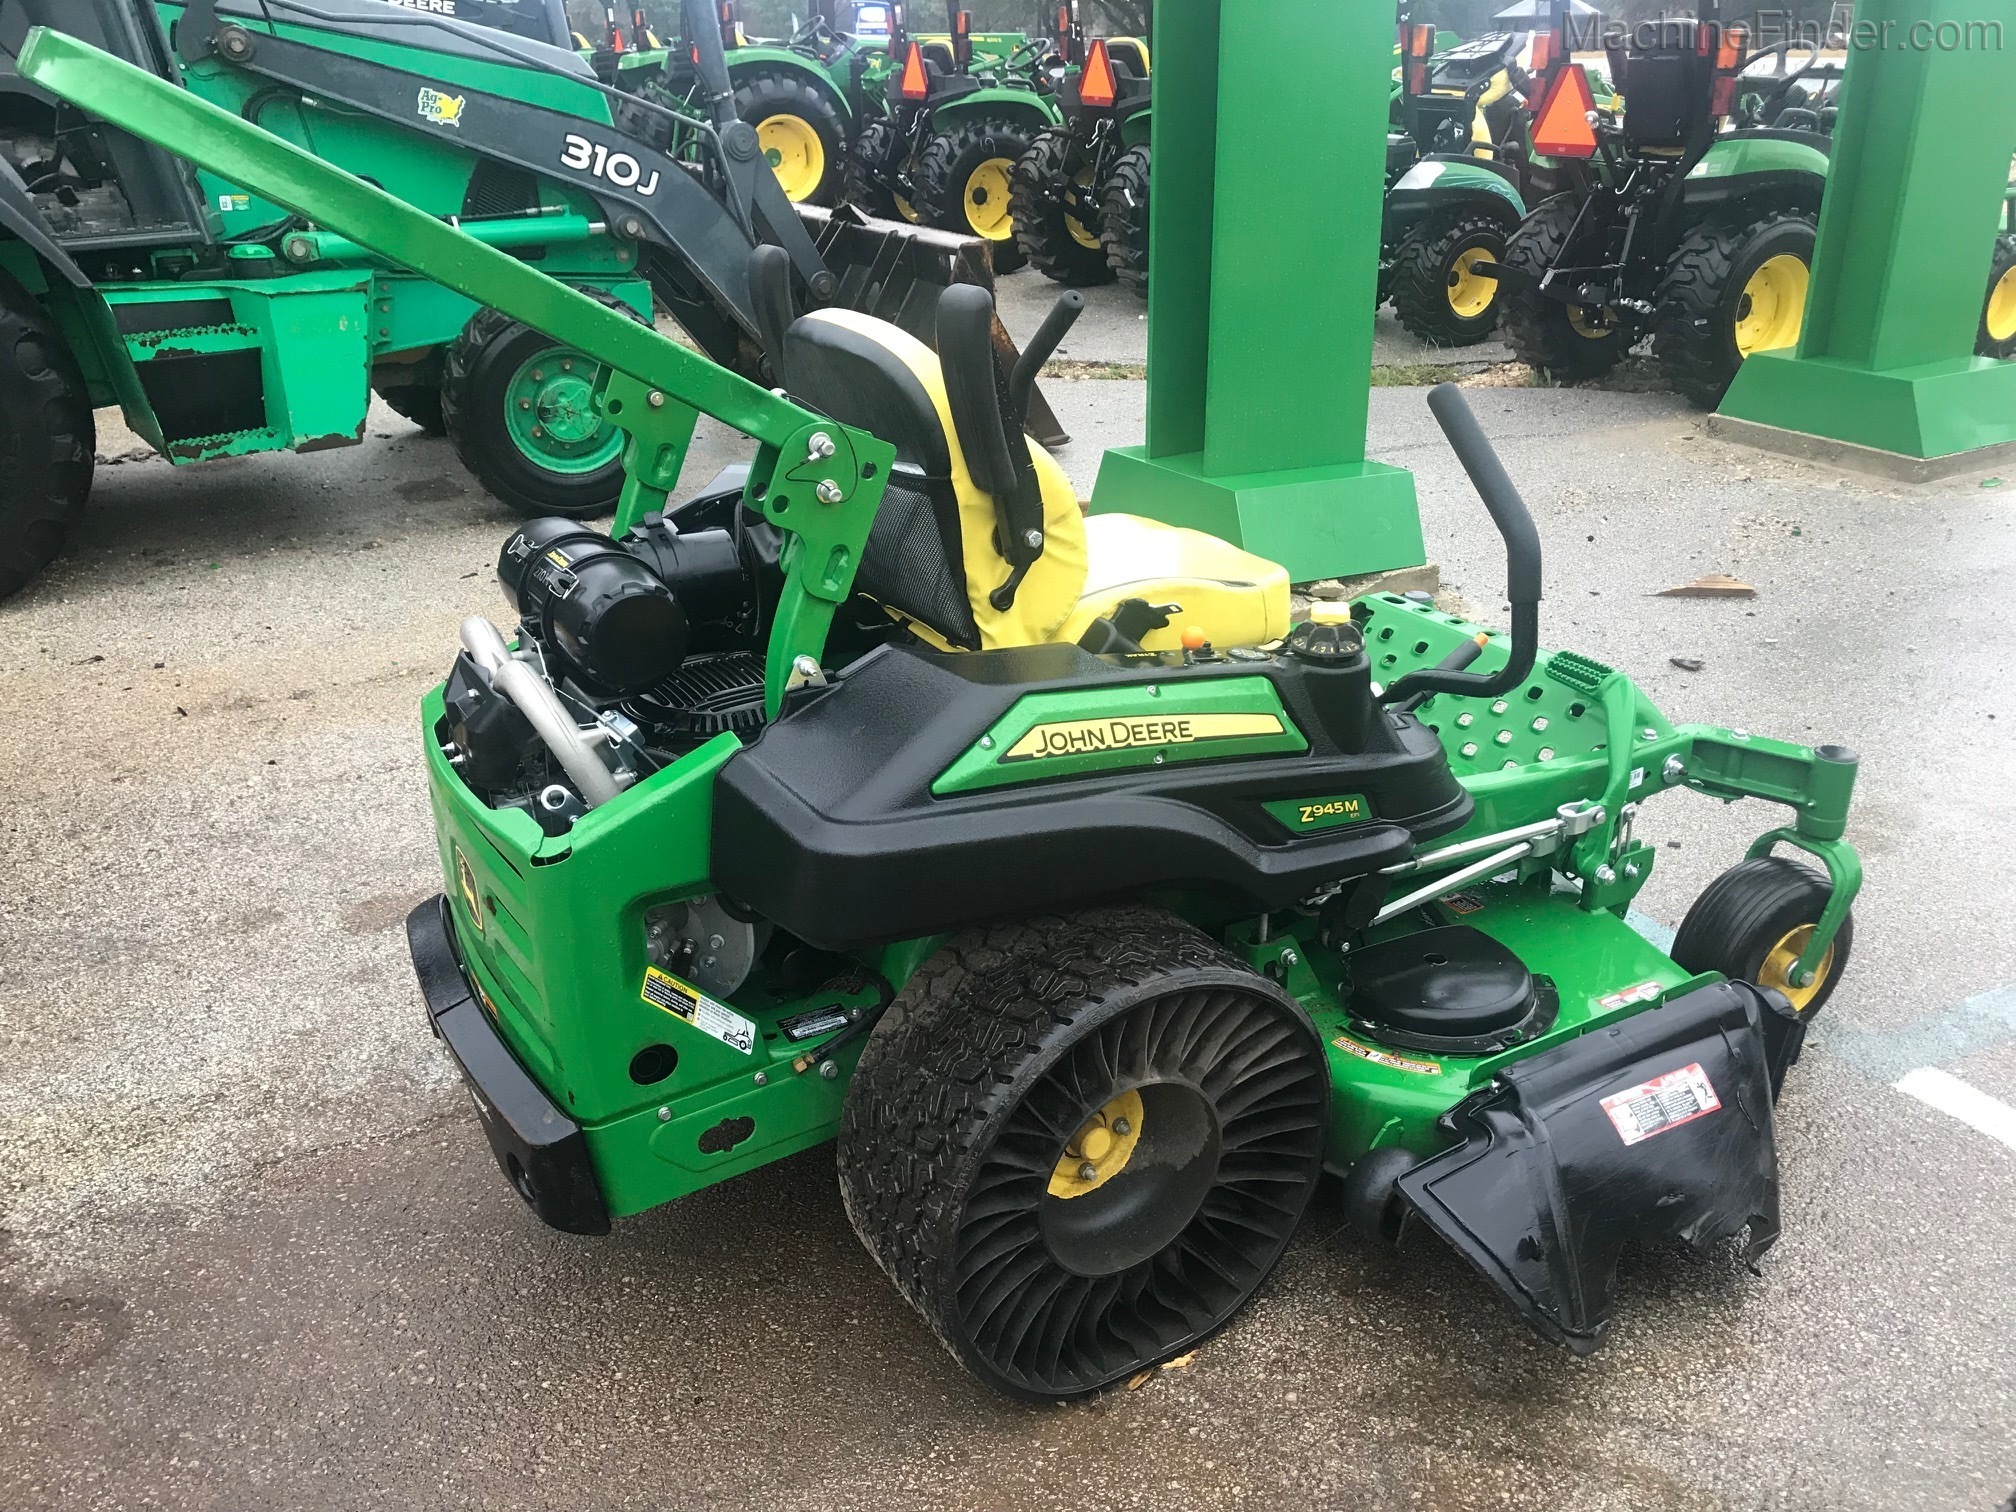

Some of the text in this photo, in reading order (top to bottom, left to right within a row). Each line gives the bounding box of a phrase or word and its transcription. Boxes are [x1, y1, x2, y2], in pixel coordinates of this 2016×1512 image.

[421, 101, 442, 114] Pro
[560, 134, 660, 196] 310J
[1035, 720, 1193, 753] JOHN DEERE
[1299, 799, 1359, 823] Z945M
[662, 975, 689, 994] CAUTION
